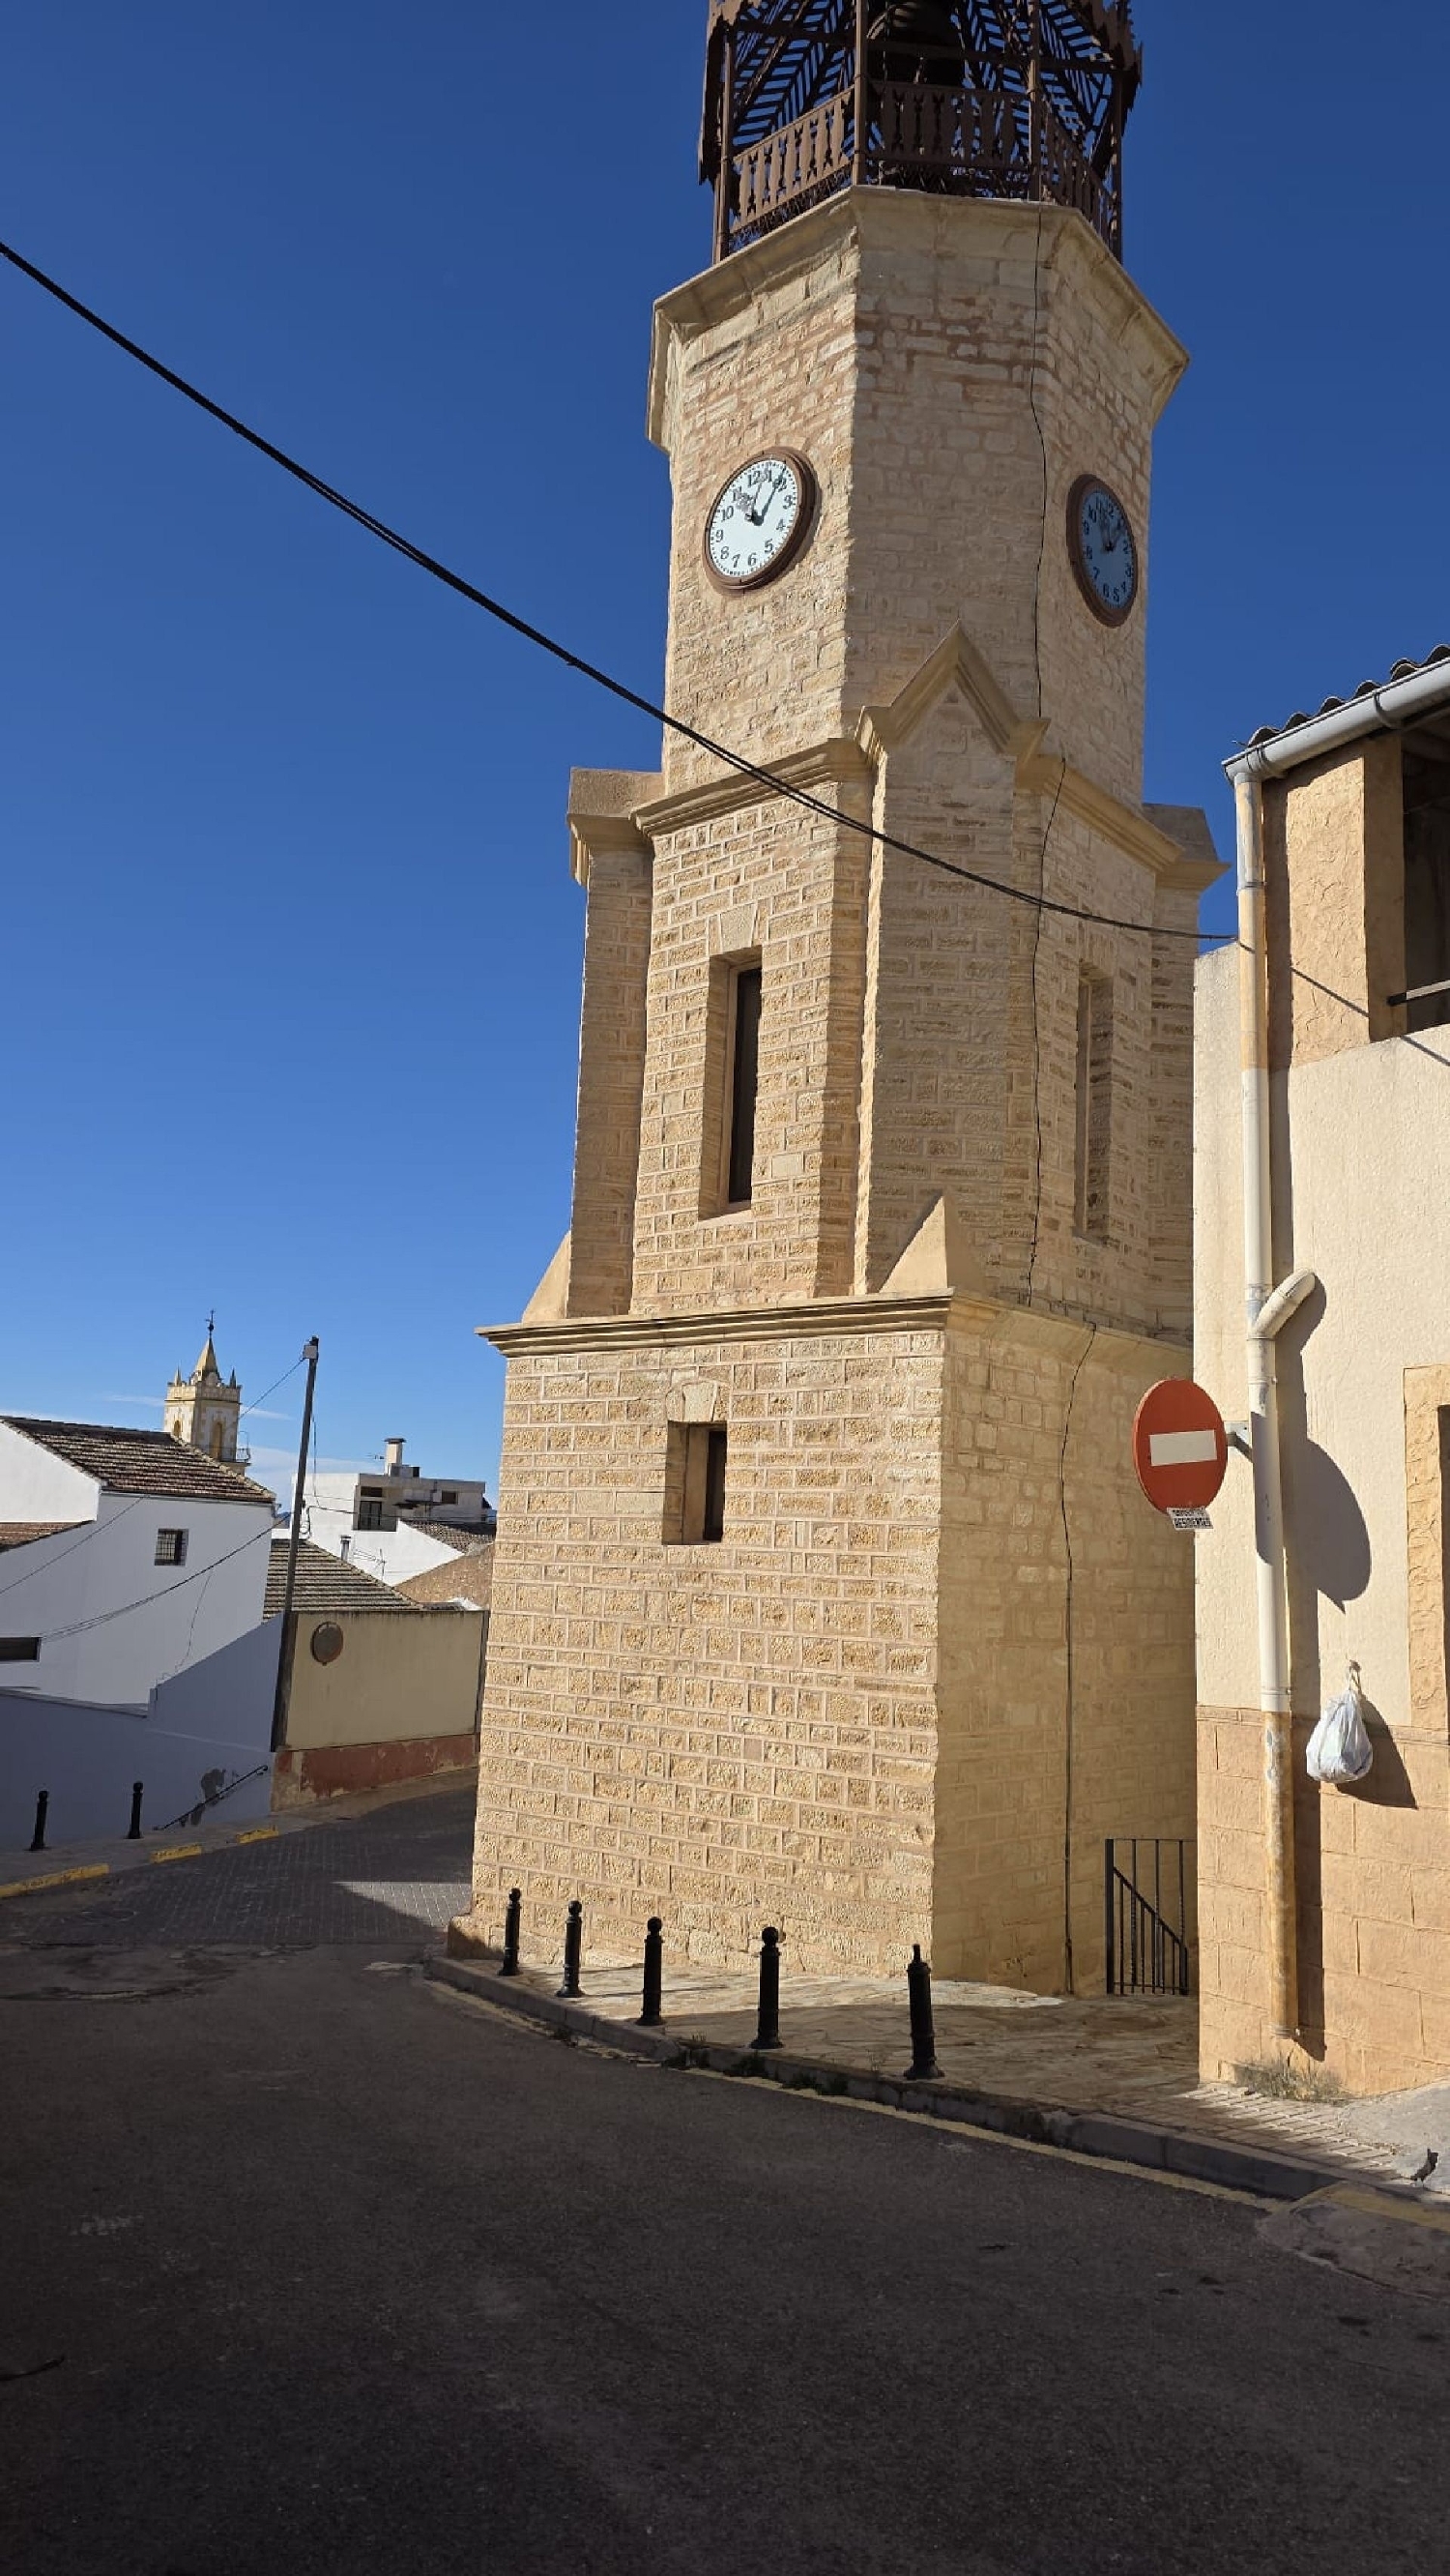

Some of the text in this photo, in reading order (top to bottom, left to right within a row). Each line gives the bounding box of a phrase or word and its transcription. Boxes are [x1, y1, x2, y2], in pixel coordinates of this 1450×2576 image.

[783, 495, 793, 510] 3
[721, 505, 734, 522] 10
[775, 519, 786, 532] 4
[715, 529, 724, 542] 9
[720, 546, 729, 560] 8
[765, 539, 773, 554] 5
[732, 554, 740, 568] 7
[747, 552, 757, 567] 6
[1092, 566, 1100, 578] 7
